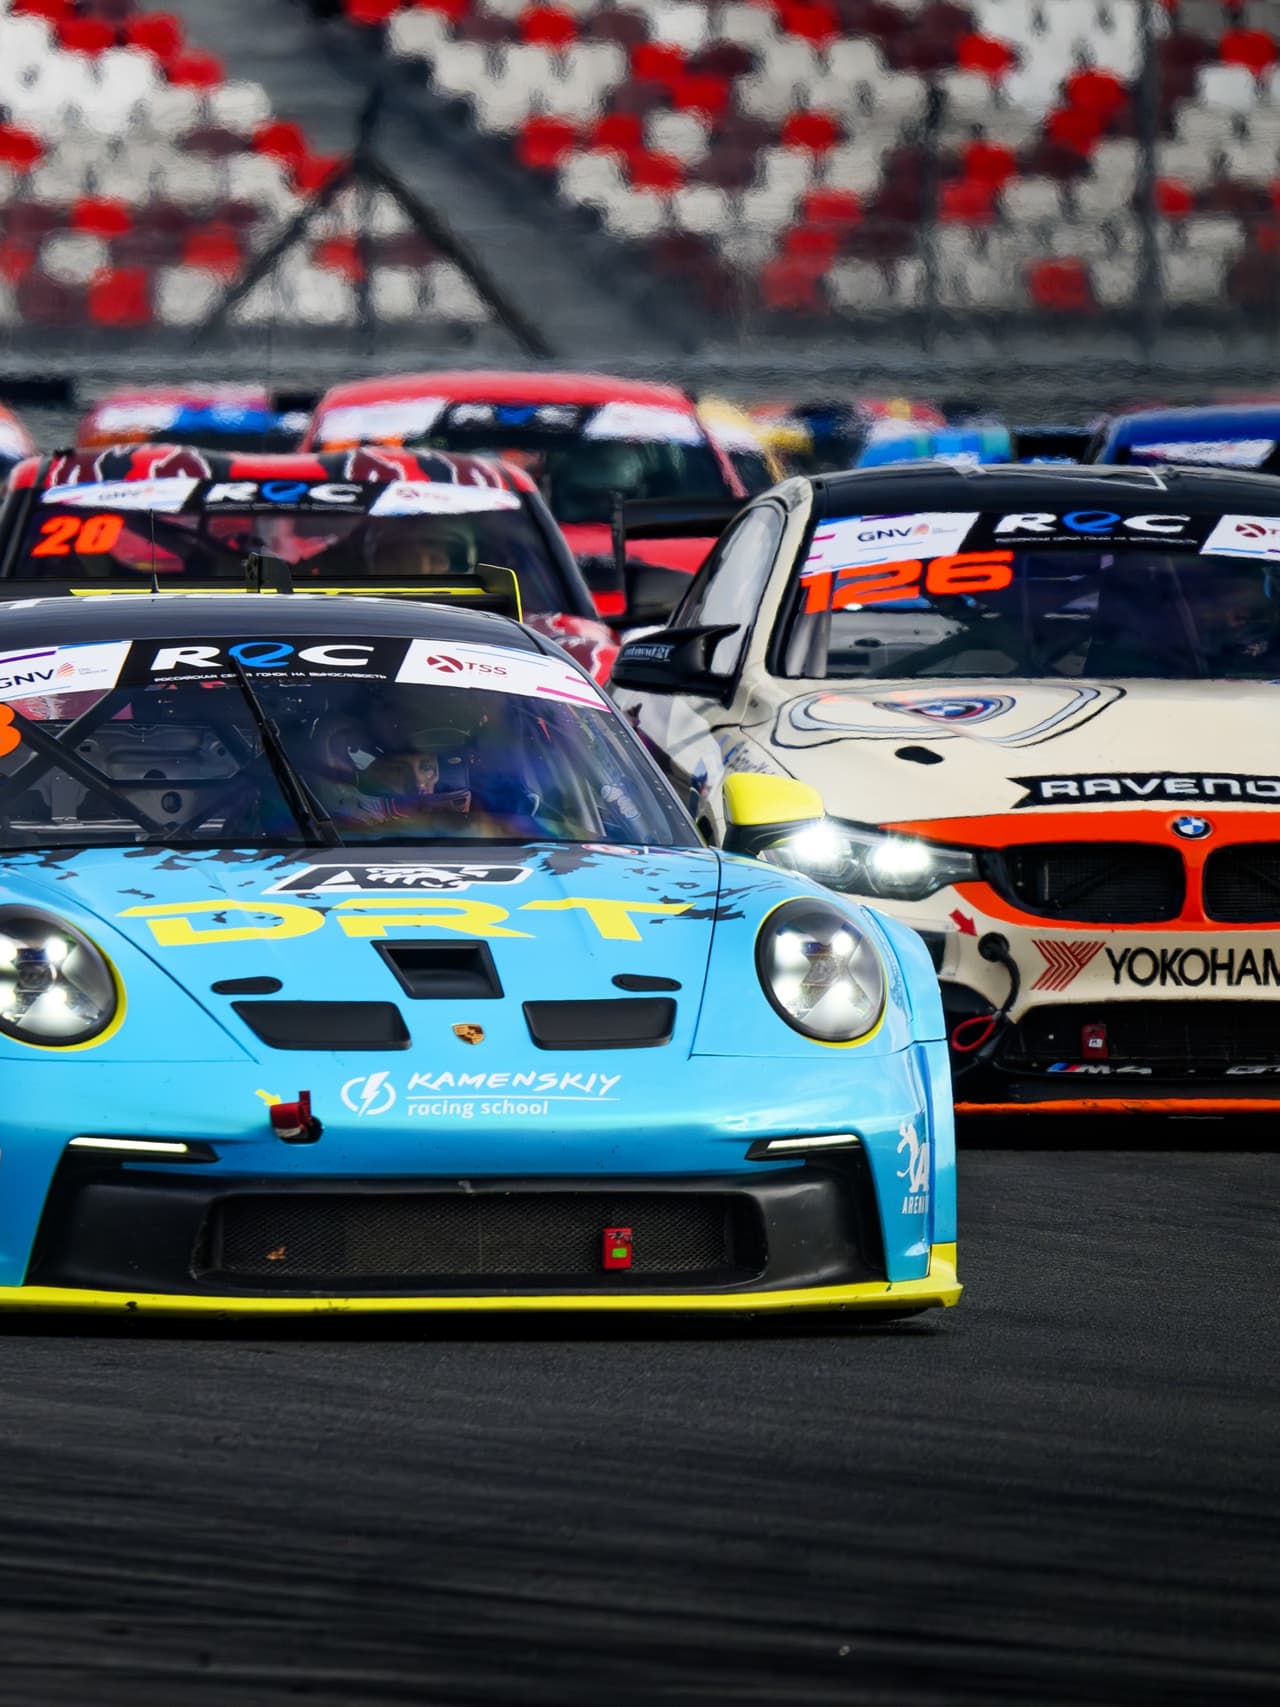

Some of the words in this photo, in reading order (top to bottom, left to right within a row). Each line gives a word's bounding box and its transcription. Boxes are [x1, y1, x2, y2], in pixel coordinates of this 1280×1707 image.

[30, 512, 126, 558] 20
[857, 526, 912, 543] GNV
[800, 549, 1015, 615] 126
[464, 661, 508, 677] TSS
[116, 897, 697, 947] DRT
[407, 1070, 622, 1097] KAMENSKIY
[407, 1100, 474, 1120] racing
[480, 1098, 549, 1116] school
